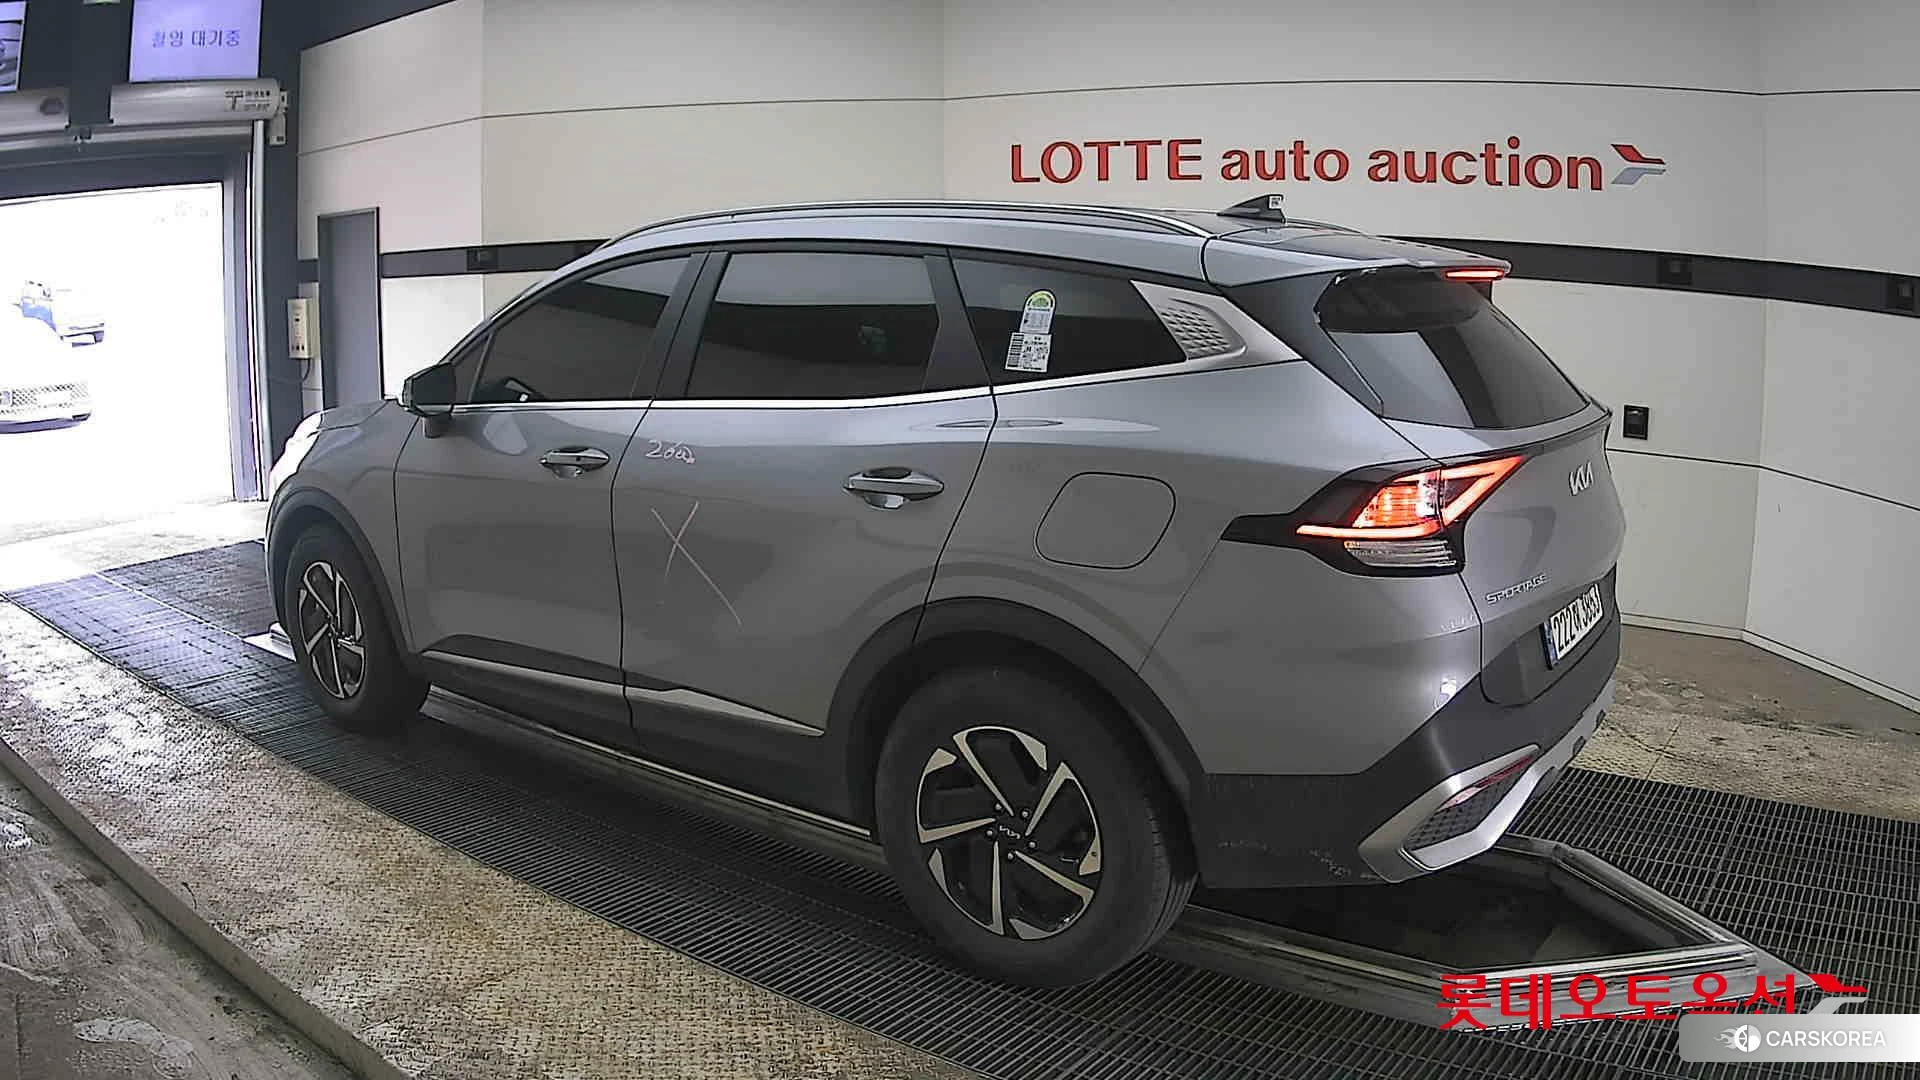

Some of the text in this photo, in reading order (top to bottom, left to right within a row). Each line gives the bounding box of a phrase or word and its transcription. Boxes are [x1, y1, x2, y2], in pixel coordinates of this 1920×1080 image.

[1011, 136, 1603, 190] LOTTE auto auction
